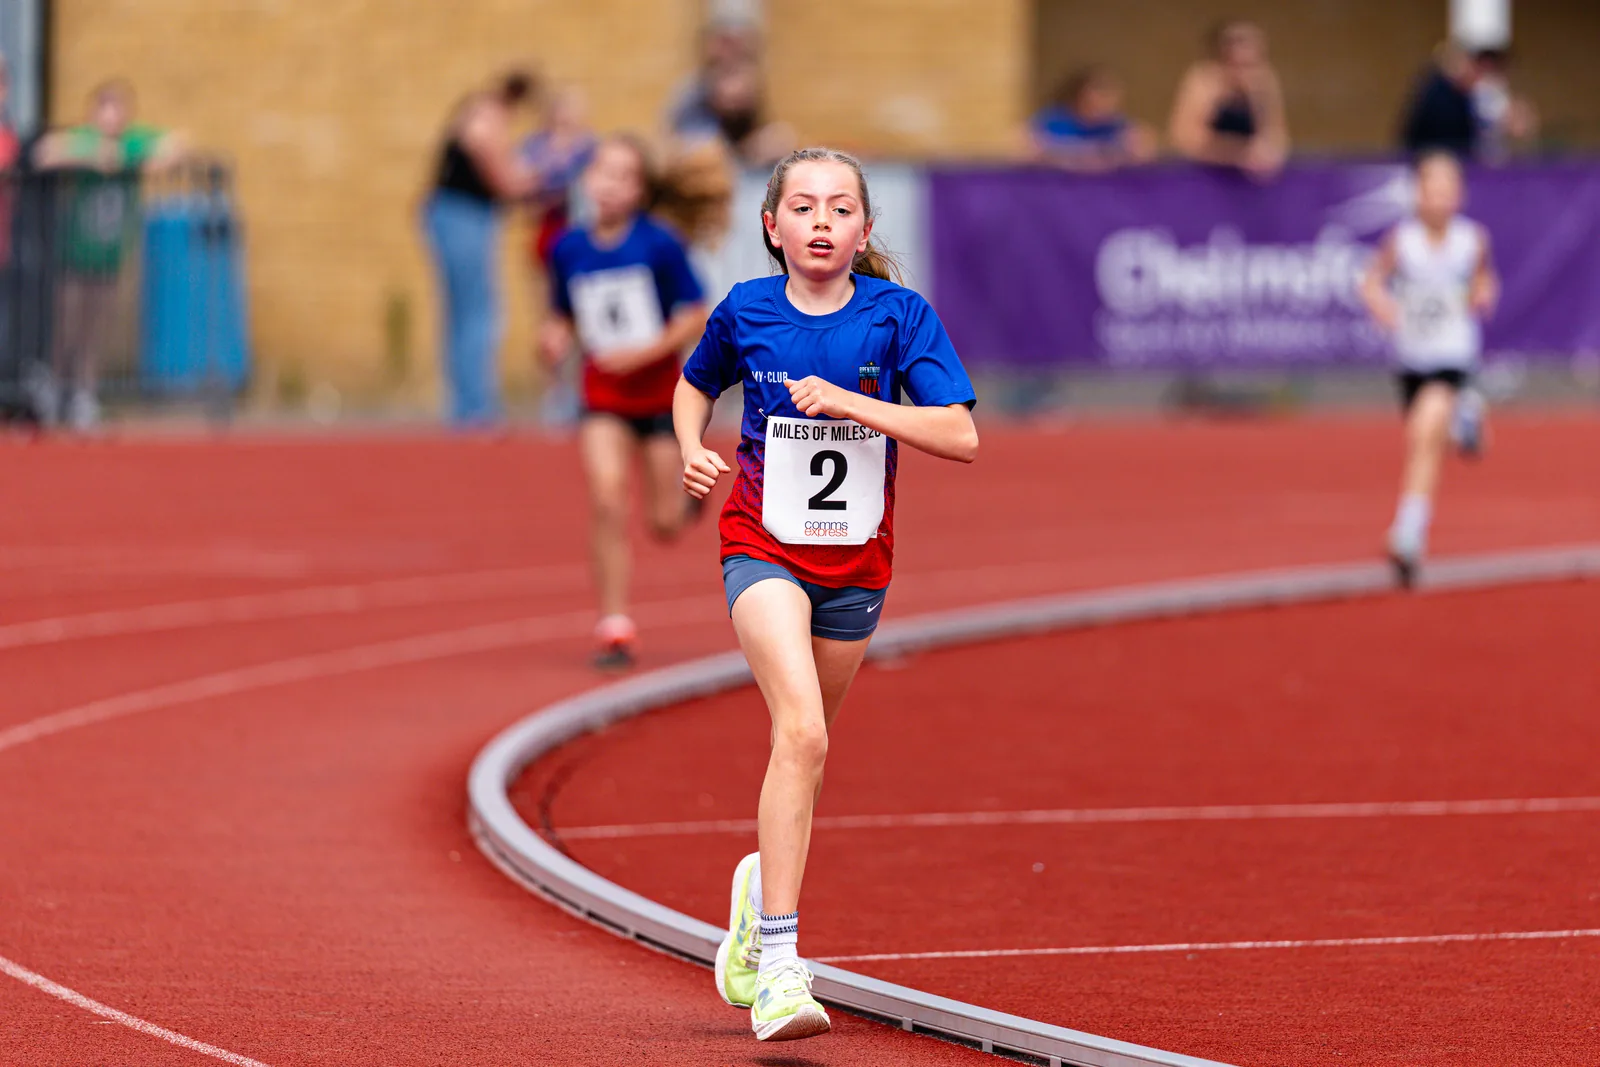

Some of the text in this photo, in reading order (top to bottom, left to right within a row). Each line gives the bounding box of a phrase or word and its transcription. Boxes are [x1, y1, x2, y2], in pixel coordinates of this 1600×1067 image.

[772, 423, 809, 440] MILES
[812, 426, 828, 441] OF
[831, 426, 866, 441] MILES
[808, 450, 848, 511] 2
[804, 520, 848, 530] comms
[804, 528, 848, 537] express
